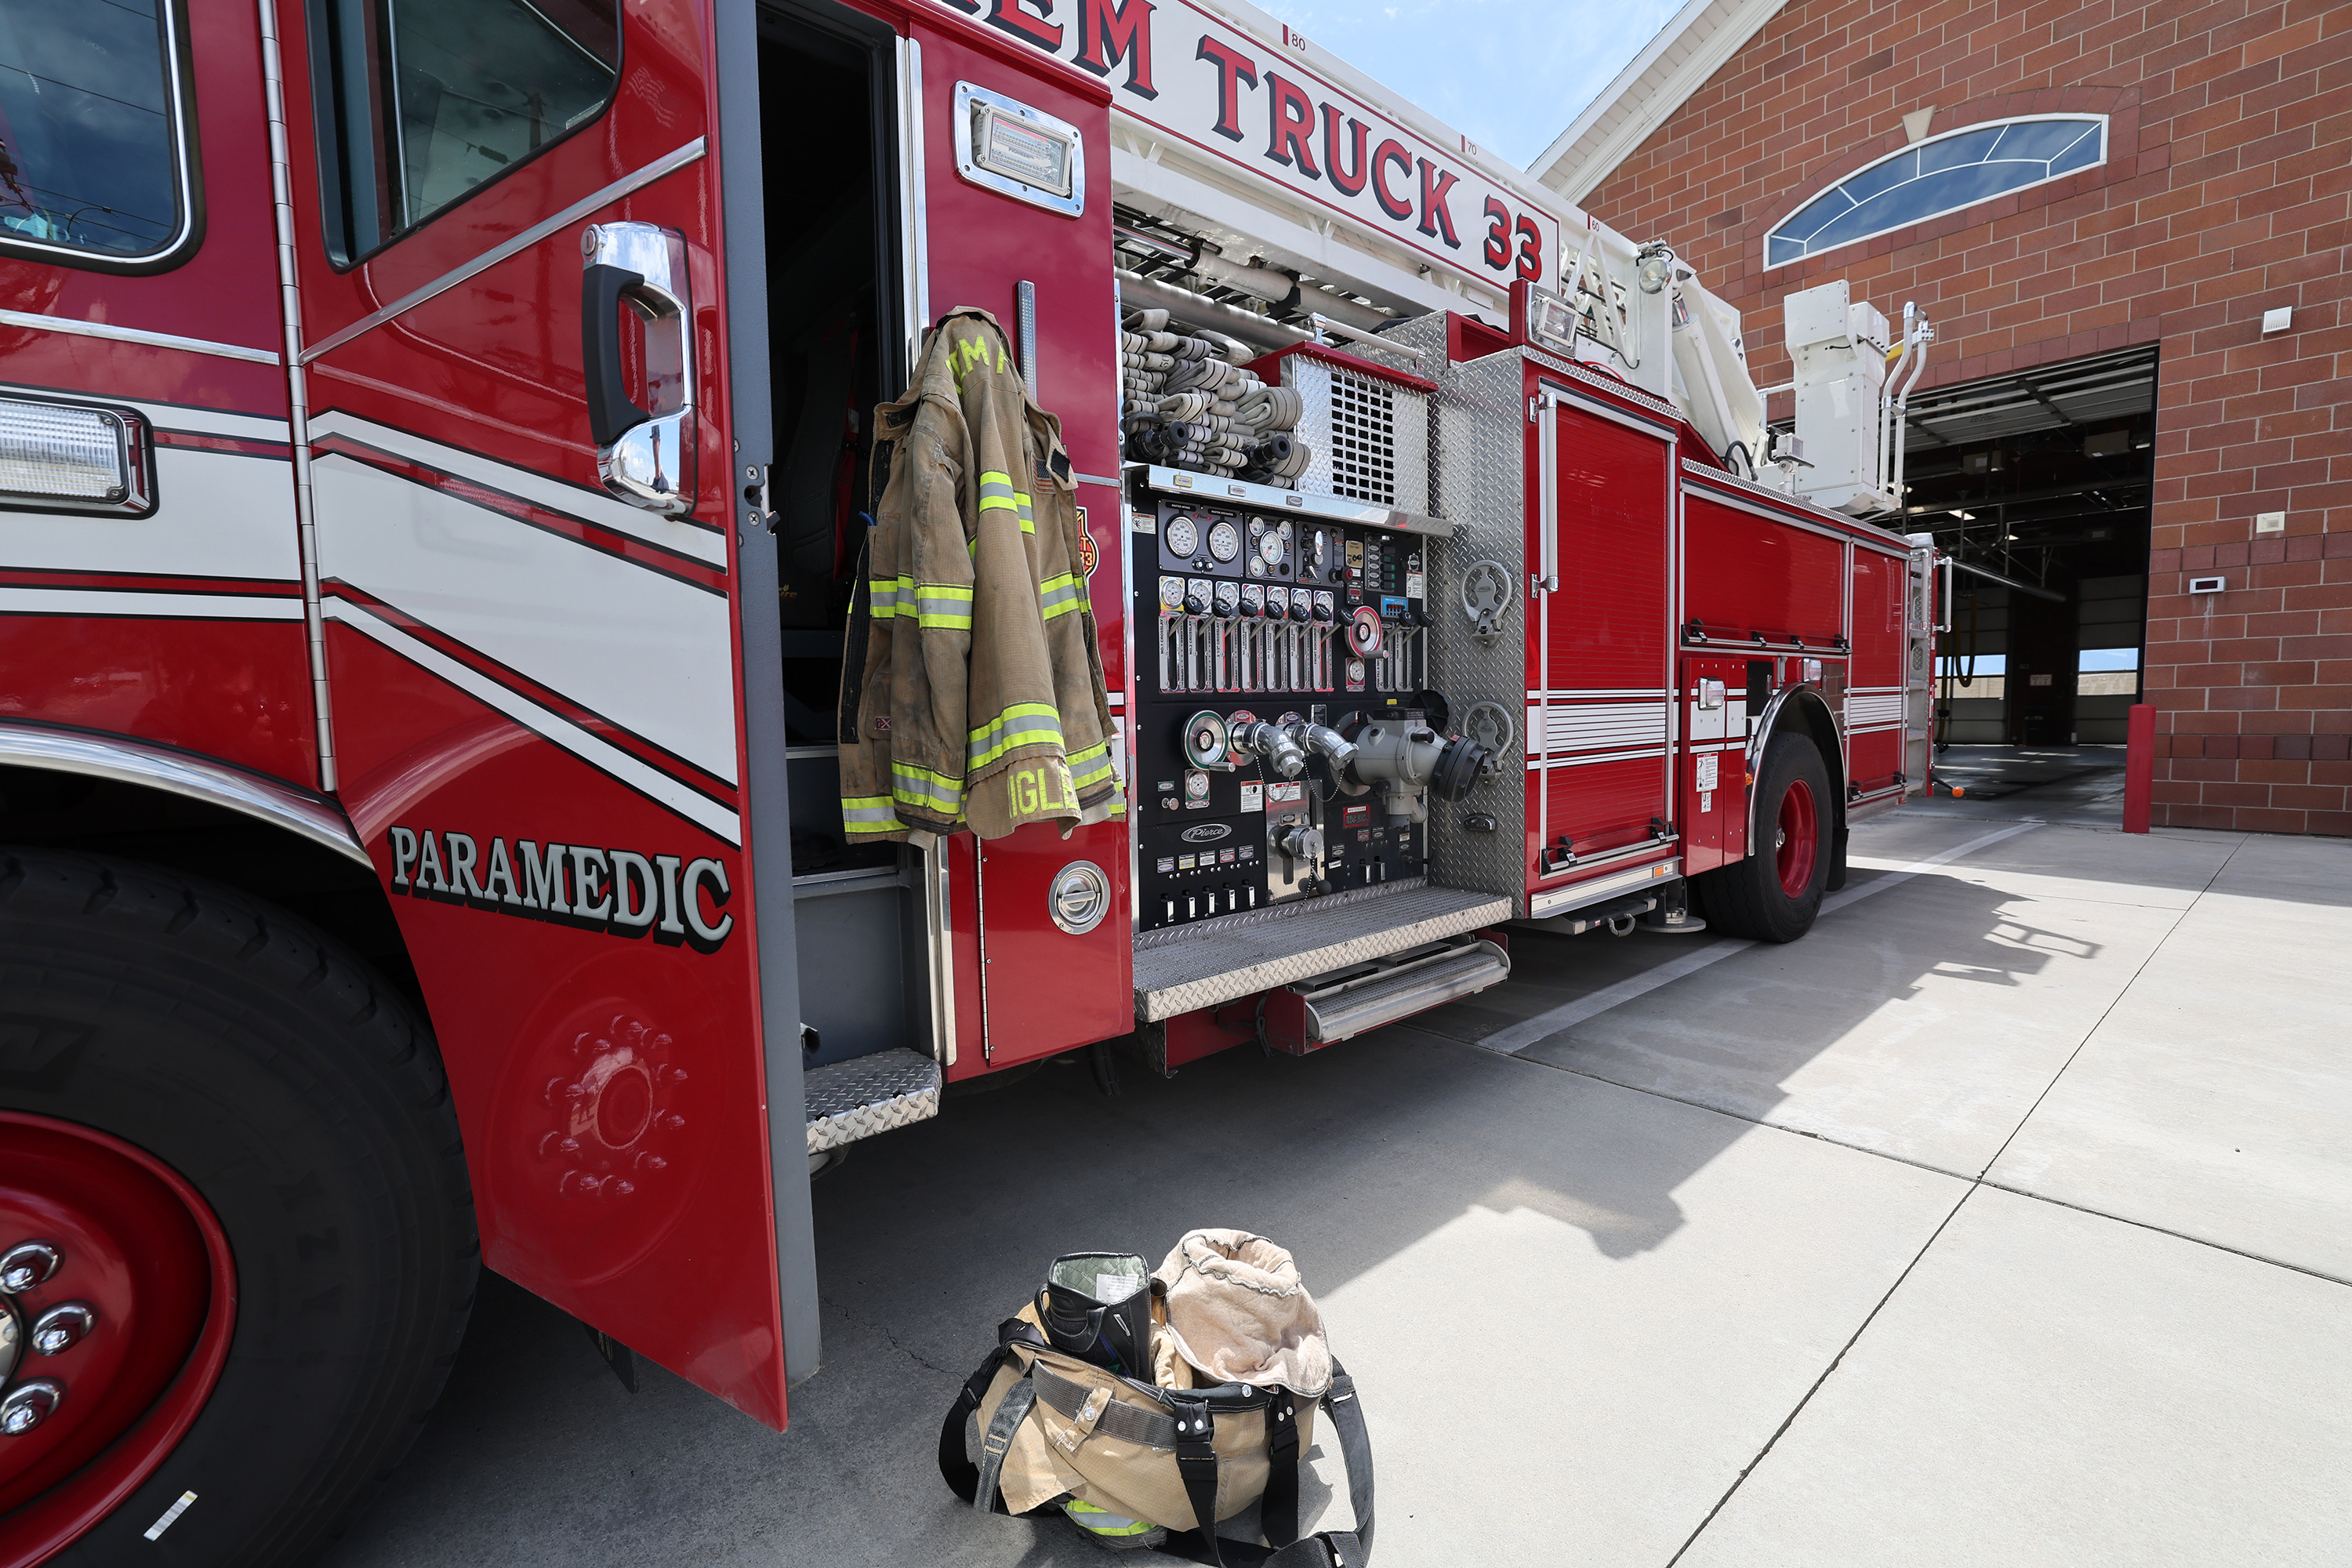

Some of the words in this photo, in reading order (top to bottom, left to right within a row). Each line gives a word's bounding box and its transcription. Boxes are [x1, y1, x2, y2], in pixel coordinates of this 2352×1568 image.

[1291, 33, 1305, 51] 80
[933, 0, 1160, 101] EM
[1195, 34, 1461, 250] TRUCK
[1483, 194, 1542, 285] 33
[1468, 142, 1477, 155] 70
[1008, 765, 1080, 819] IGLE
[1190, 828, 1224, 839] Pierce
[387, 826, 734, 954] PARAMEDIC
